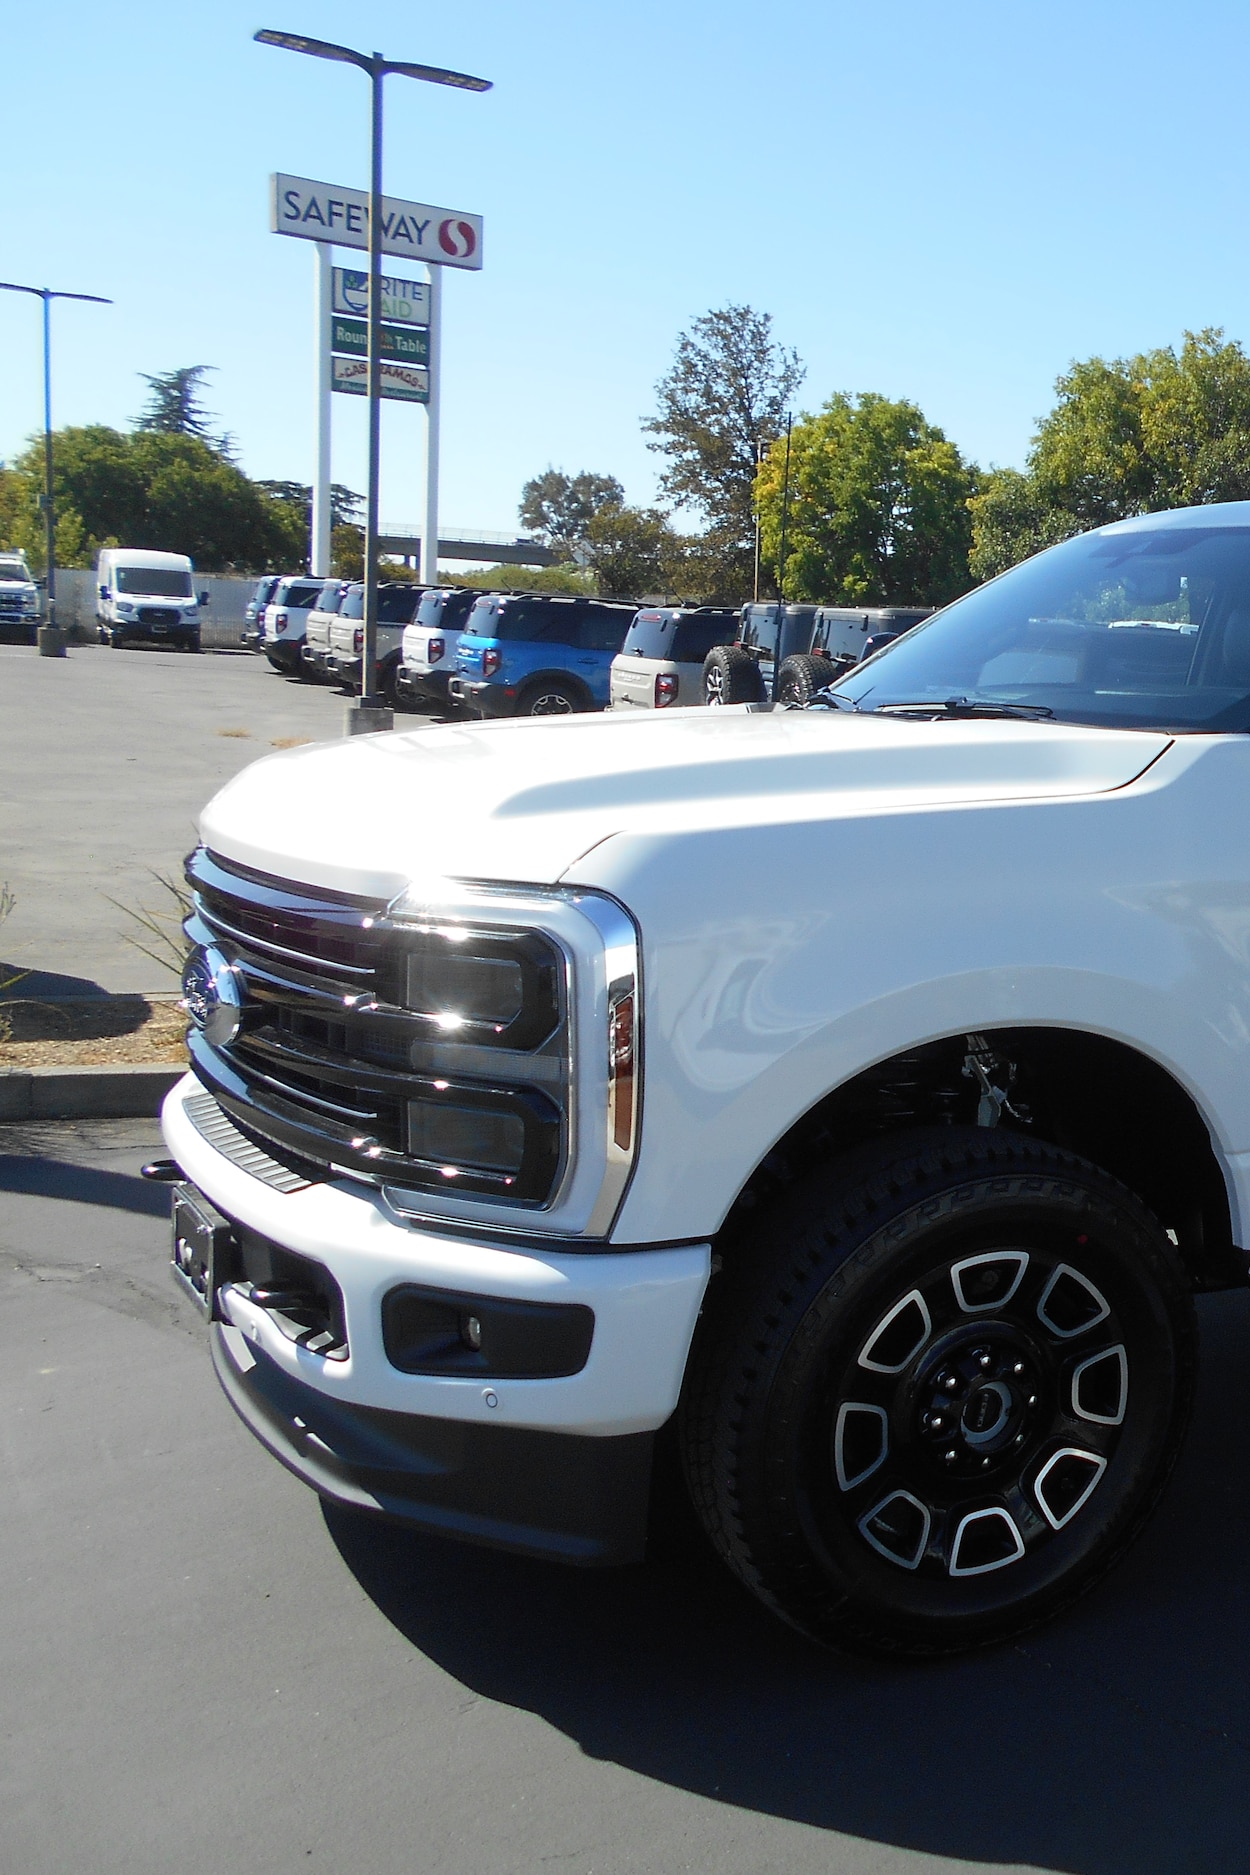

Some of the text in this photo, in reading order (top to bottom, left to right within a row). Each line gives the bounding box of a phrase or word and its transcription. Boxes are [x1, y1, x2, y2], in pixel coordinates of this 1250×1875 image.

[284, 190, 431, 245] SAFEWAY
[380, 277, 424, 301] RITE
[381, 297, 413, 318] AID
[336, 325, 427, 354] Roun Table
[344, 363, 368, 378] CAS
